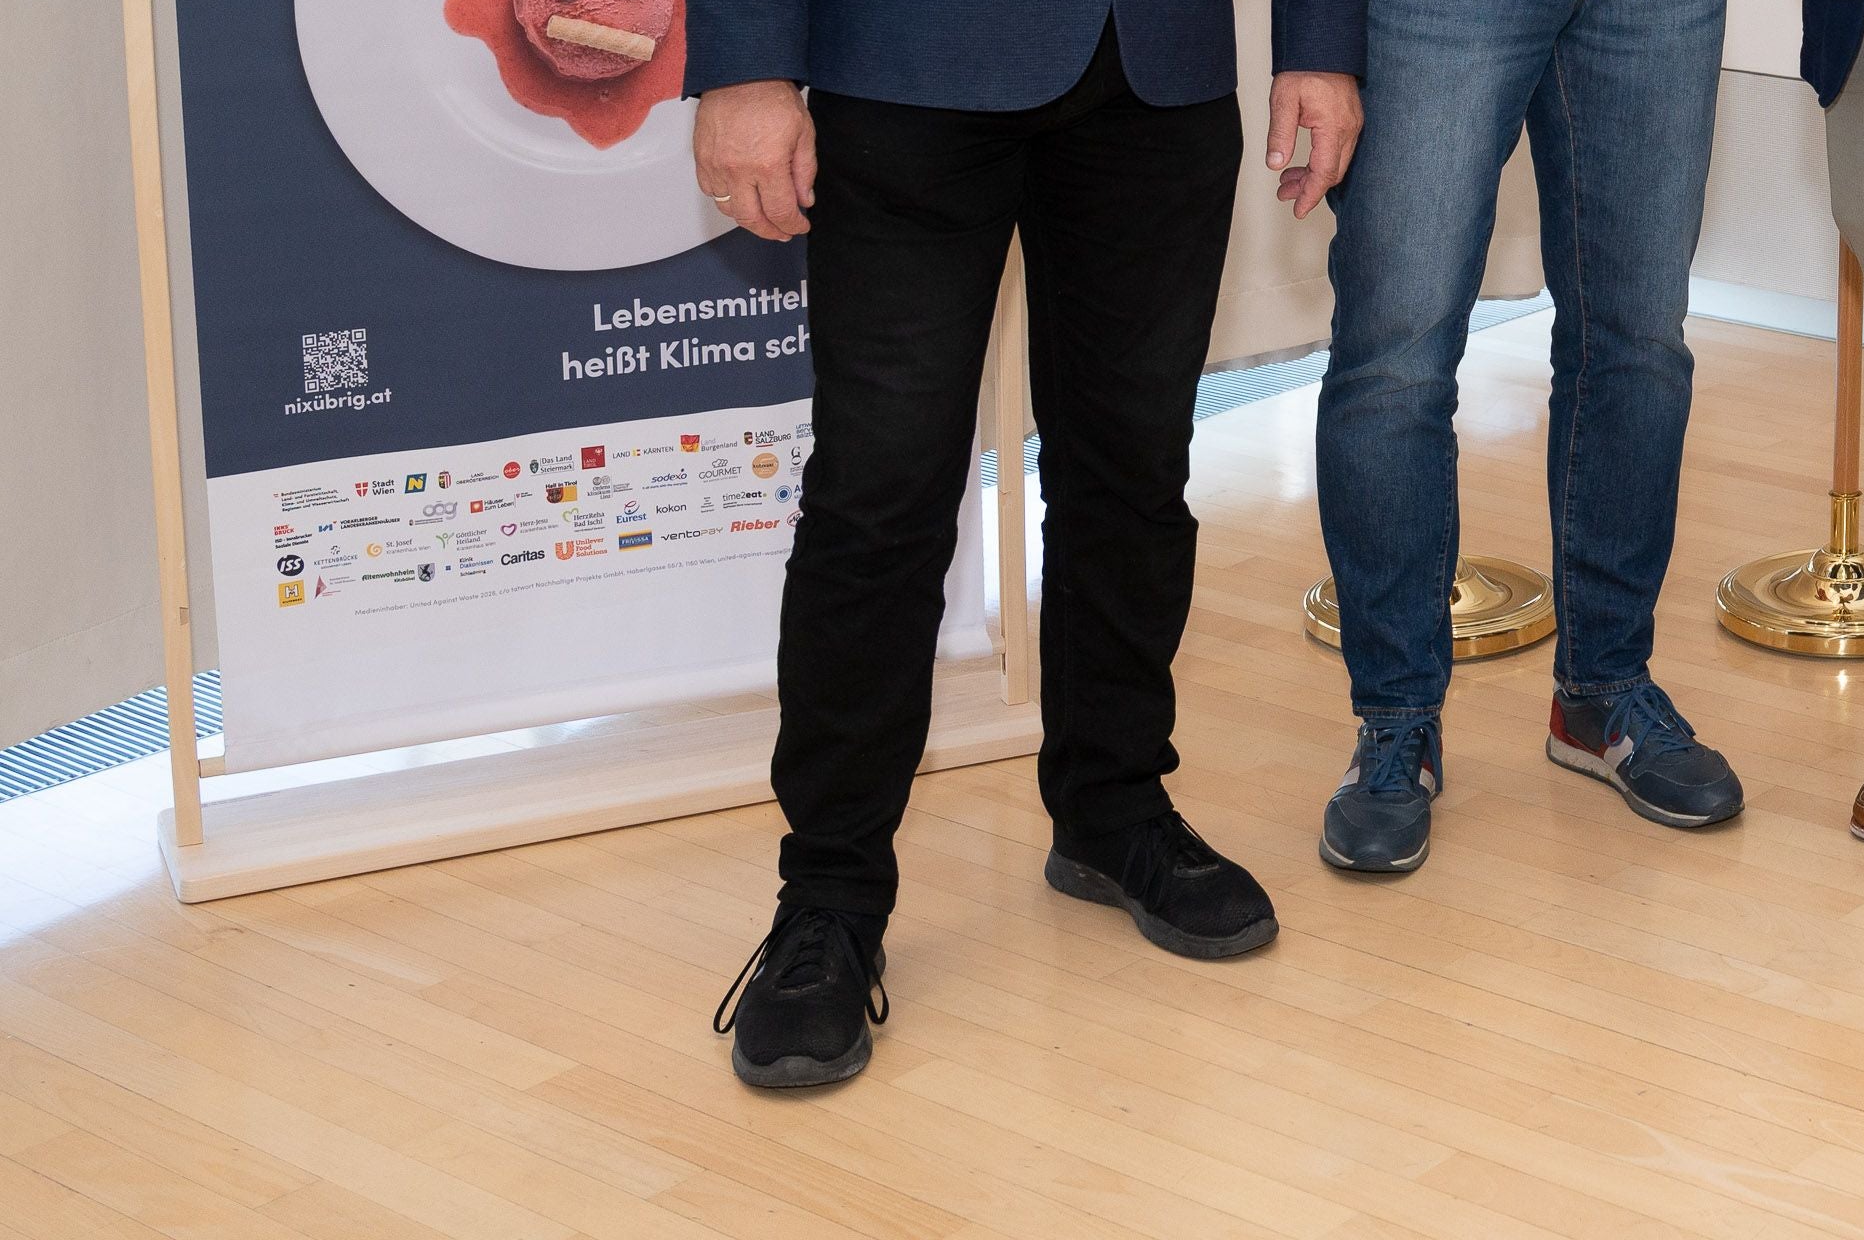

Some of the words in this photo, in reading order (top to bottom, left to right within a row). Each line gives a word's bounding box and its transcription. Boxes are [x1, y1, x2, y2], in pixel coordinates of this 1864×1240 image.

[593, 279, 808, 331] Lebensmittel
[562, 345, 650, 381] heißt
[660, 337, 756, 370] Klima
[284, 387, 393, 416] nixübrig.at
[755, 430, 775, 438] LAND
[756, 433, 792, 445] SALZBURG
[701, 438, 716, 446] Land
[701, 441, 738, 452] Burgenland
[612, 451, 630, 459] LAND
[644, 446, 674, 455] KÄRNTEN
[556, 454, 573, 462] Land
[540, 464, 573, 474] Steiermark
[698, 466, 743, 480] GOURMET
[651, 468, 688, 484] sodexo
[372, 480, 395, 488] Stadt
[372, 488, 395, 496] Wien
[484, 498, 504, 506] Häuser
[656, 504, 687, 514] kokon
[574, 511, 605, 522] HerzReha
[616, 512, 648, 524] Eurest
[520, 518, 548, 528] Herz-Jesu
[574, 520, 587, 528] Bad
[588, 518, 604, 526] Ischl
[730, 519, 781, 533] Rieber
[456, 529, 488, 539] Göttlicher
[386, 540, 396, 548] St.
[396, 538, 412, 547] Josef
[456, 536, 481, 546] Heiland
[576, 538, 604, 546] Unilever
[576, 544, 592, 552] Food
[576, 548, 608, 558] Solutions
[313, 554, 359, 566] KETTENBRÜCKE
[500, 548, 546, 566] Caritas
[280, 558, 302, 572] ISS
[460, 559, 494, 570] Diakonissen
[354, 603, 408, 616] Medieninhaber:
[410, 599, 432, 608] United
[433, 596, 458, 608] Against
[458, 592, 479, 602] Waste
[576, 574, 602, 584] Projekte
